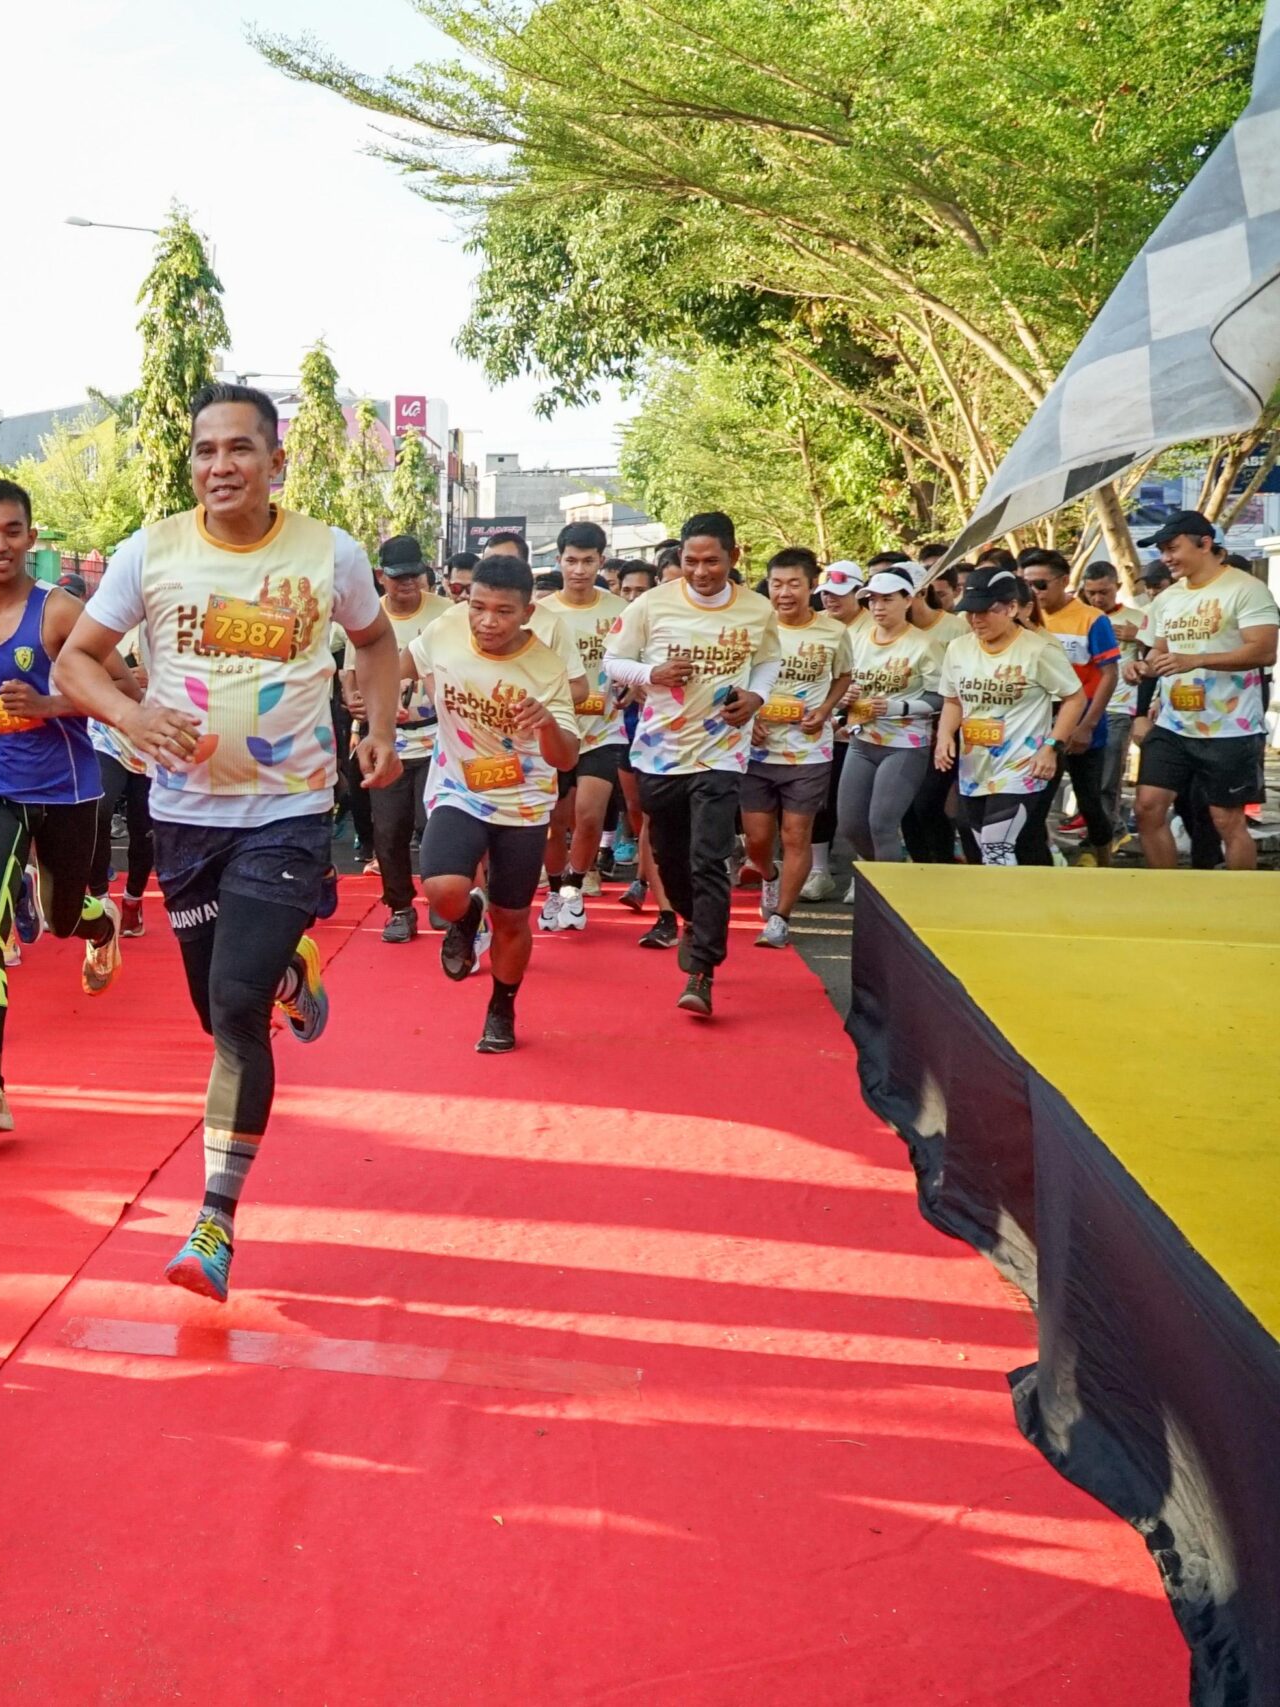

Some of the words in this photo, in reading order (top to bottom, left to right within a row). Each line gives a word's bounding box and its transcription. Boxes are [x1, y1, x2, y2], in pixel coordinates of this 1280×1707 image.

[215, 616, 285, 648] 7387
[1187, 629, 1210, 641] Run
[704, 661, 737, 675] Run
[785, 668, 817, 682] Run
[981, 691, 1013, 706] Run
[765, 704, 800, 718] 7393
[965, 727, 1001, 741] 7348
[471, 765, 517, 786] 7225
